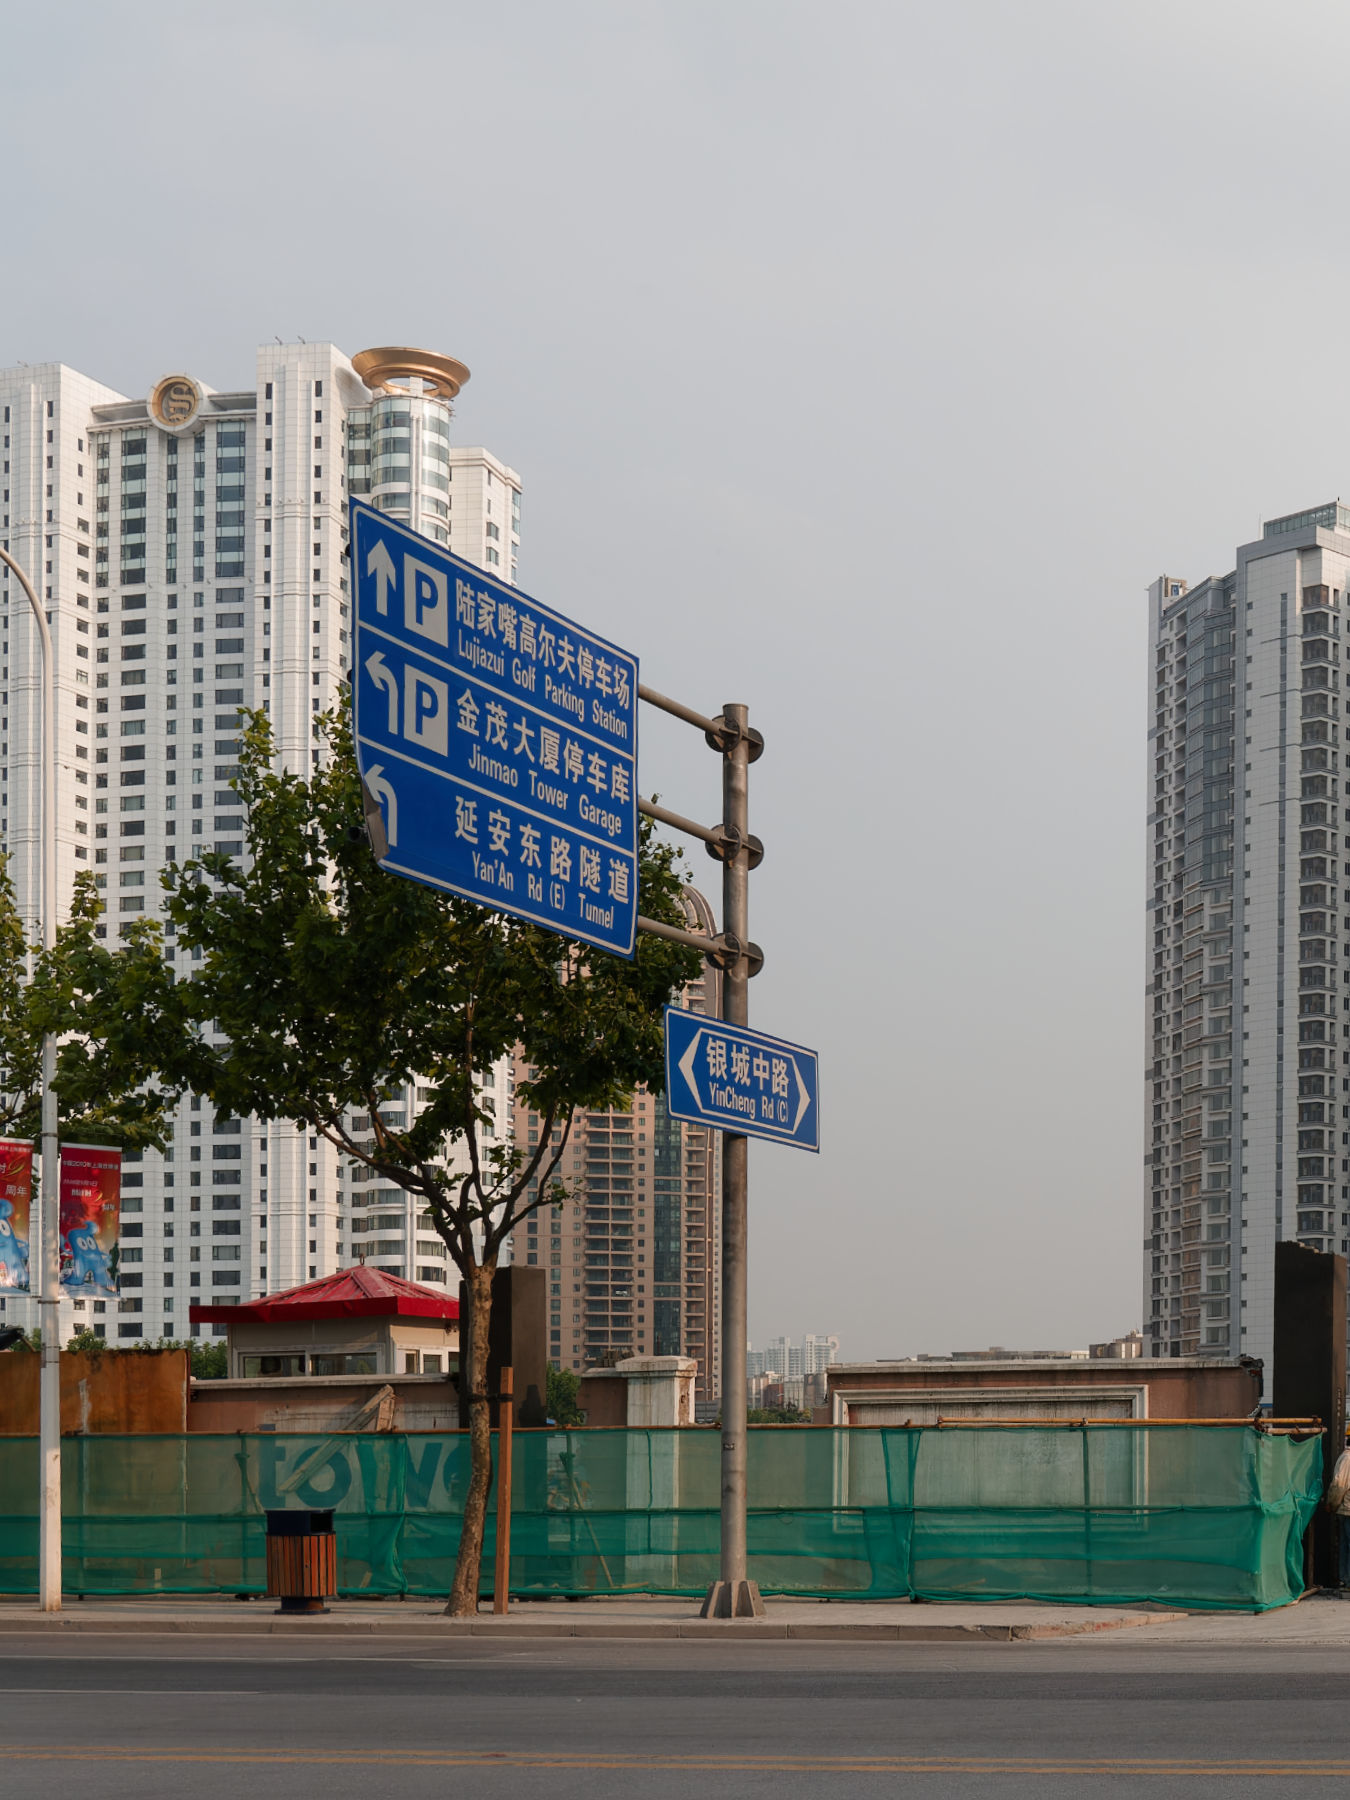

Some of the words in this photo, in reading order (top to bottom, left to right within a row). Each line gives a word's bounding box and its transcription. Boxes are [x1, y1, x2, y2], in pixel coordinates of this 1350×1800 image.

[415, 567, 439, 627] P
[455, 578, 630, 710] 陆家嘴高尔夫停车场
[415, 678, 439, 736] P
[458, 629, 505, 677] Lujiazui
[512, 657, 536, 692] Golf
[545, 674, 585, 722] Parking
[592, 699, 628, 739] Station
[456, 688, 631, 805] 金茂大厦停车库
[468, 743, 519, 788] Jinmao
[528, 769, 569, 811] Tower
[578, 793, 622, 837] Garage
[455, 795, 630, 904] 延安东路隧道
[527, 873, 543, 902] Rd
[550, 881, 566, 911] (E)
[578, 893, 614, 930] Tunnel
[706, 1036, 789, 1099] 银城中路
[708, 1081, 756, 1120] YinCheng
[761, 1095, 774, 1119] Rd
[776, 1099, 789, 1123] (C)
